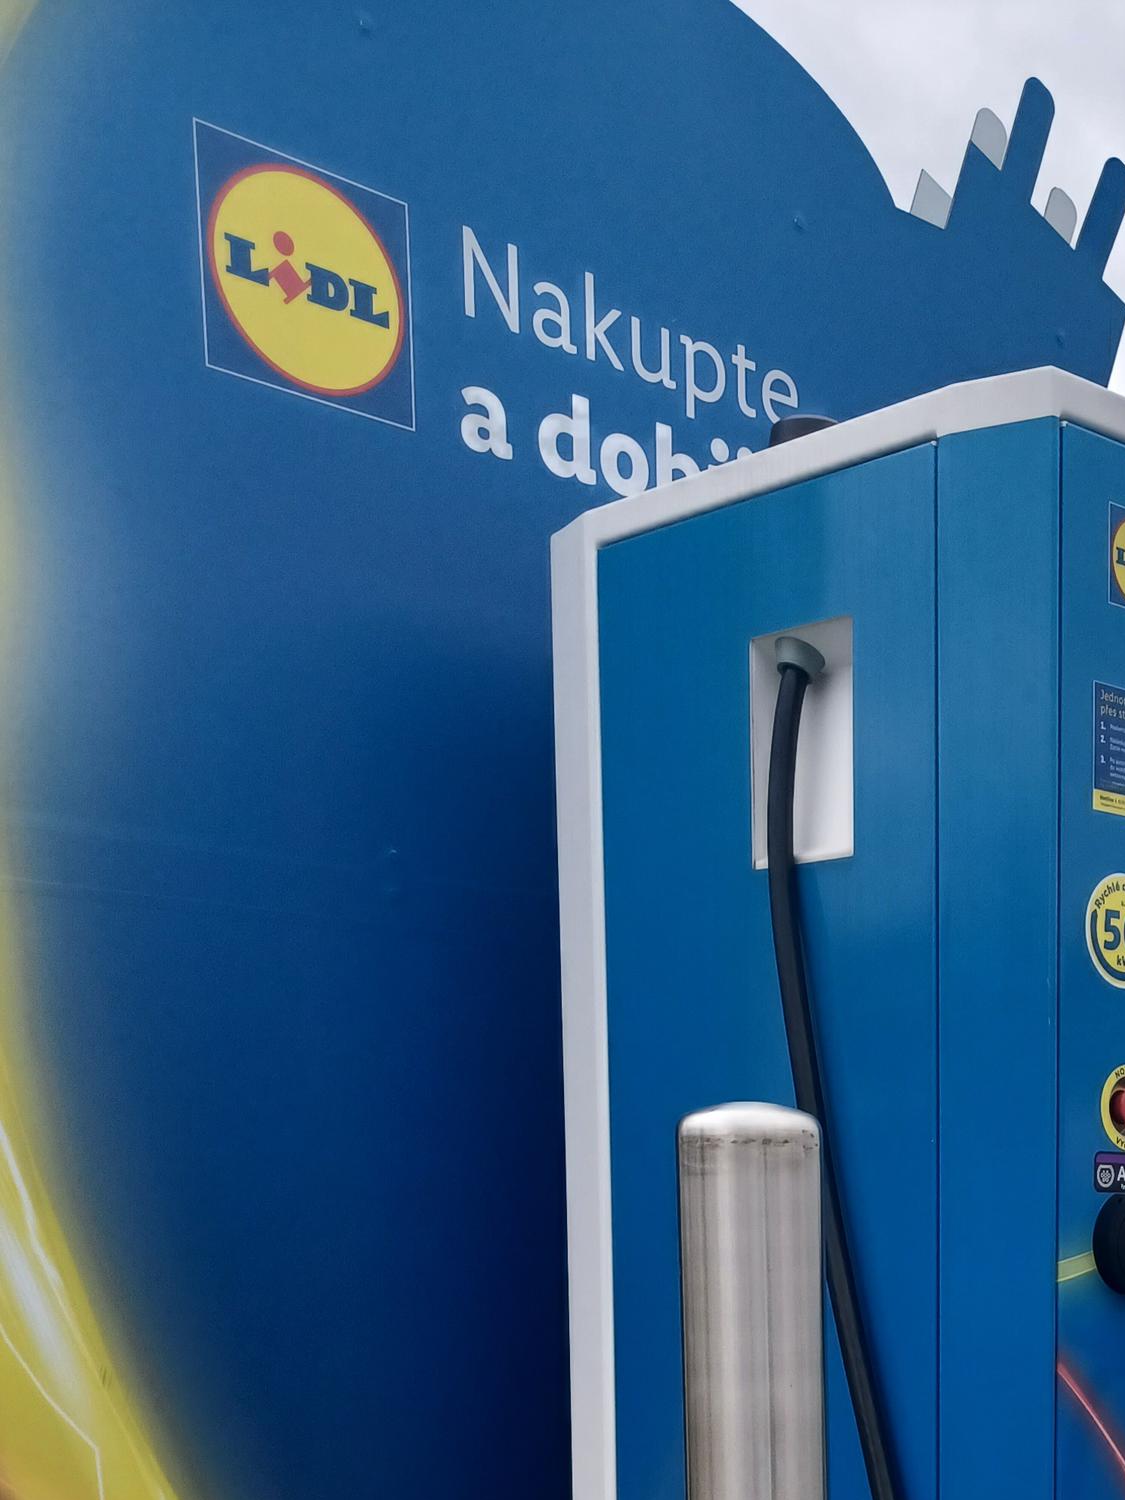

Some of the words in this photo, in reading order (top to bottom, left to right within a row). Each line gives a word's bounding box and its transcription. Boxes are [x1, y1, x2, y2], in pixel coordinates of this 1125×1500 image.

[462, 225, 798, 424] Nakupte
[460, 385, 513, 460] a
[1100, 706, 1117, 716] přes
[1094, 881, 1120, 909] Rychlé
